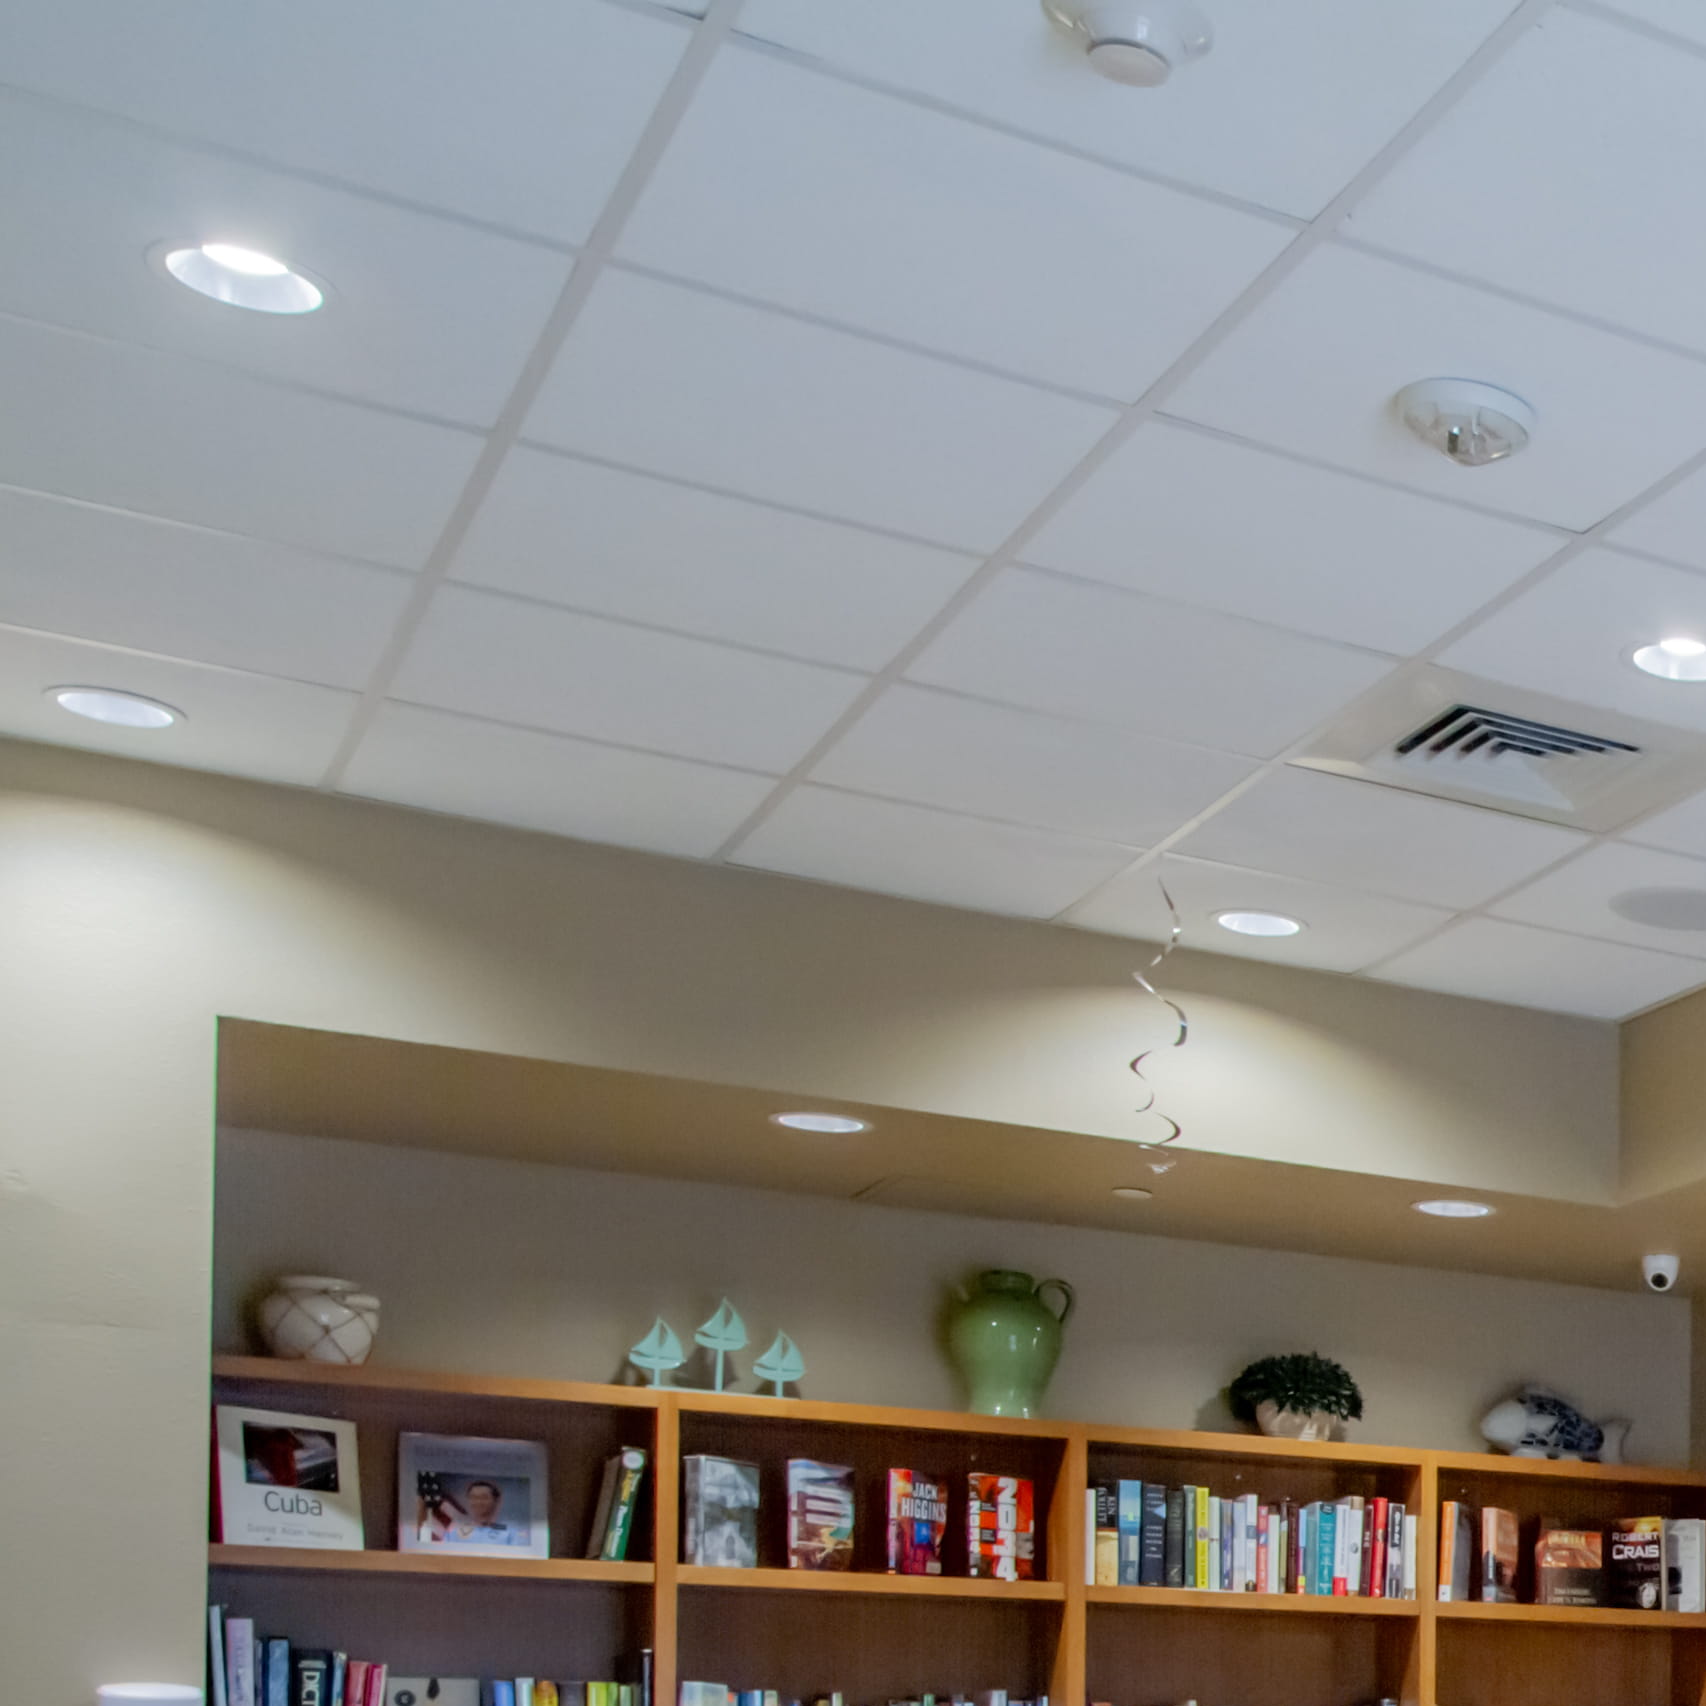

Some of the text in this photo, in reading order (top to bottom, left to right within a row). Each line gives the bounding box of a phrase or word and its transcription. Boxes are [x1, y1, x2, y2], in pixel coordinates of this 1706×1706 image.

[912, 1482, 938, 1501] JACK
[263, 1490, 323, 1517] Cuba
[901, 1497, 947, 1523] HIGGINS
[1611, 1531, 1659, 1543] ROBERT
[1612, 1544, 1660, 1561] CRAIS
